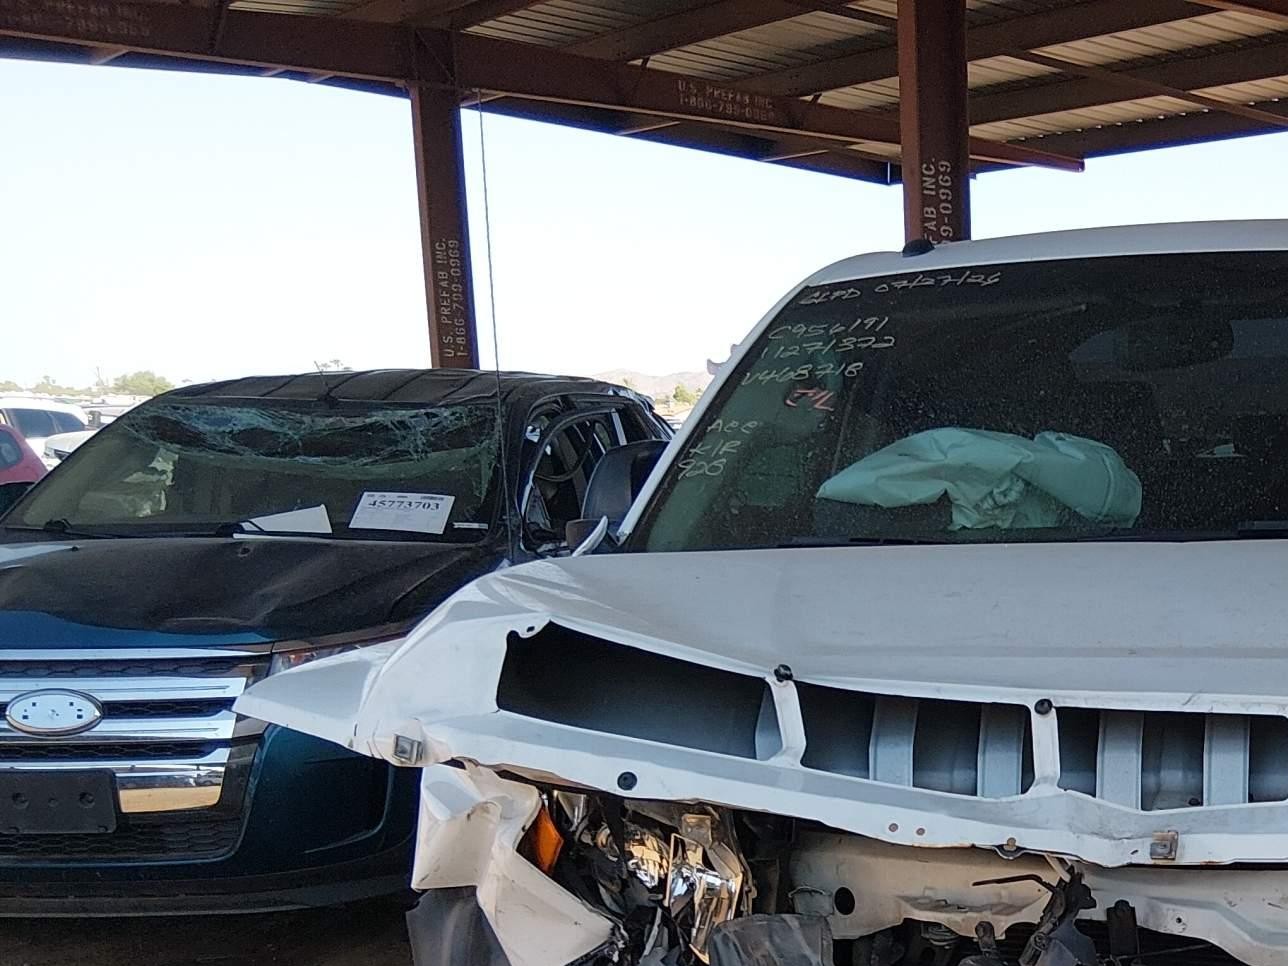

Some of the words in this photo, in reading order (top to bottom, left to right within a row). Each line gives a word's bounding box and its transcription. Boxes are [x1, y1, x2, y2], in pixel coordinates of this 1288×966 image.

[921, 157, 937, 196] INC.
[938, 160, 953, 244] 9-0969
[435, 238, 448, 264] INC.
[438, 271, 453, 324] PREFAB
[448, 240, 468, 357] 1-866-799-0969
[443, 331, 455, 357] U.S.
[368, 499, 440, 511] 45773703
